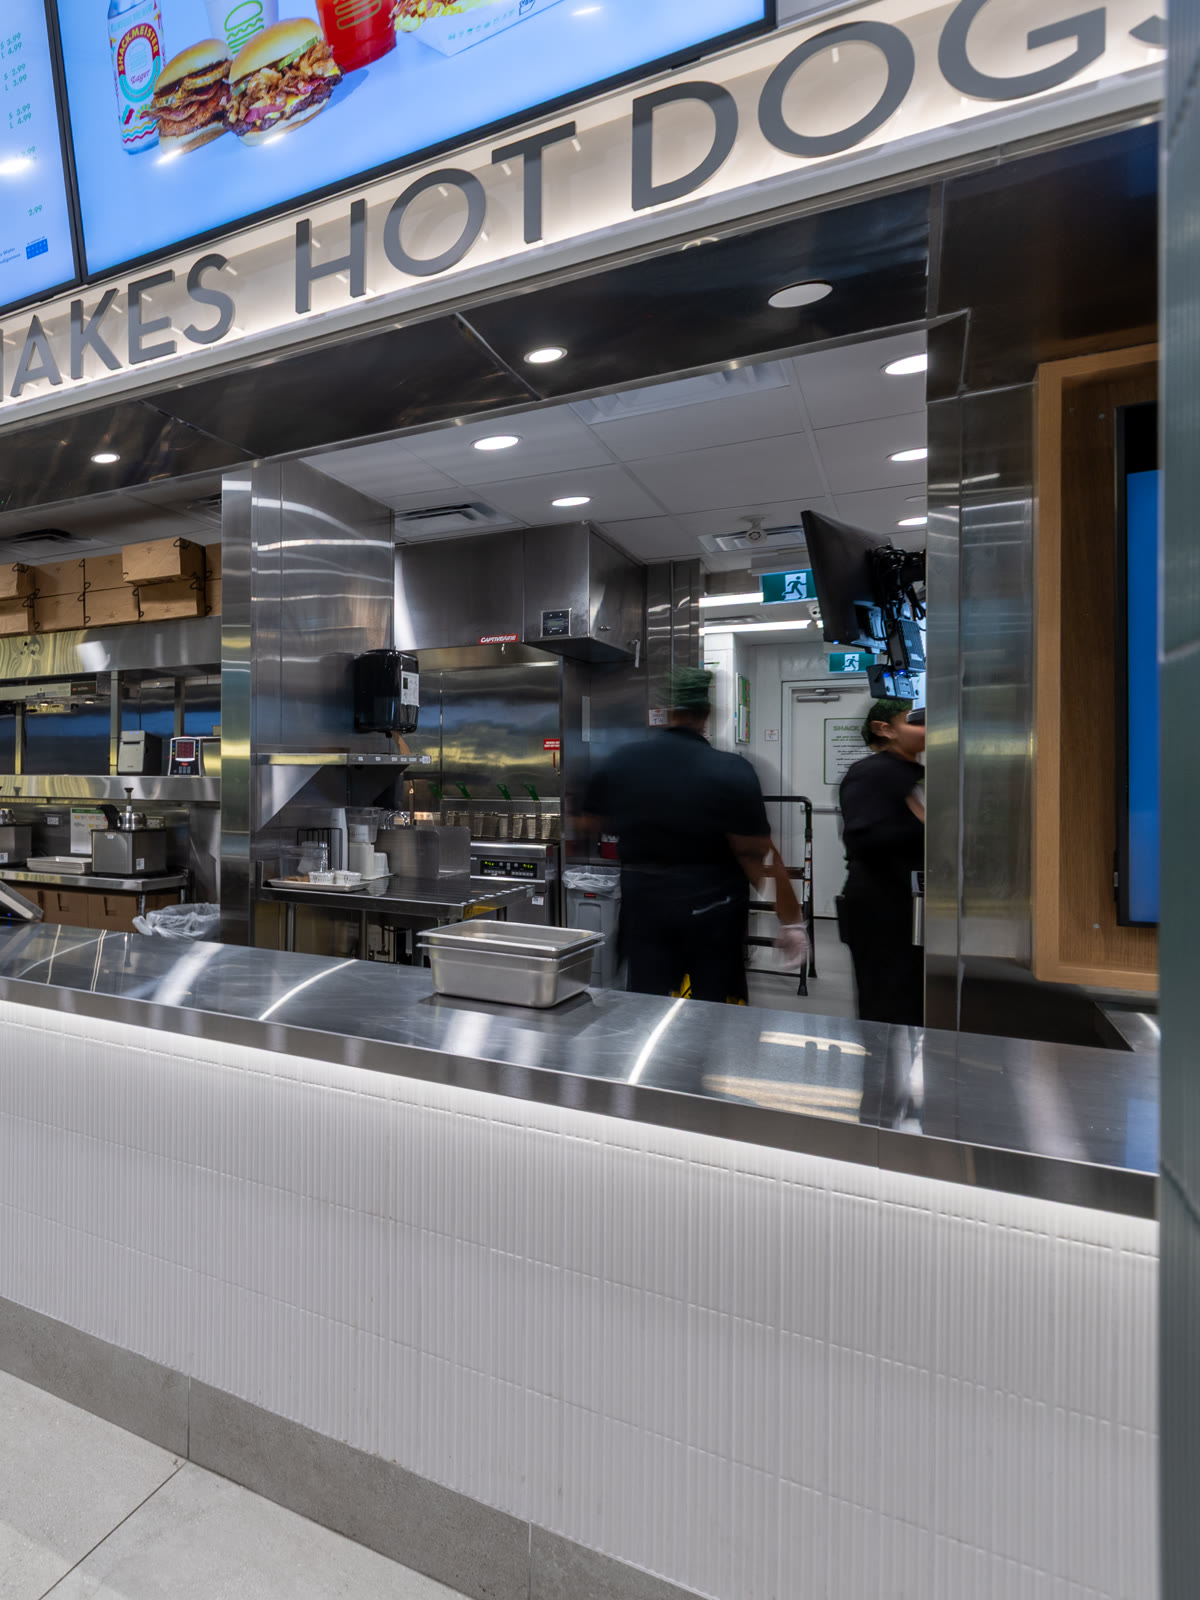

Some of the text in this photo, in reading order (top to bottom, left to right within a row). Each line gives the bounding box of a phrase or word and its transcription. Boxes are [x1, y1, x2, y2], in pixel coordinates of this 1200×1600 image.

[118, 25, 159, 72] SHACKMEISTER
[130, 69, 150, 84] Lager
[296, 121, 575, 314] HOT
[632, 0, 1165, 210] DOG
